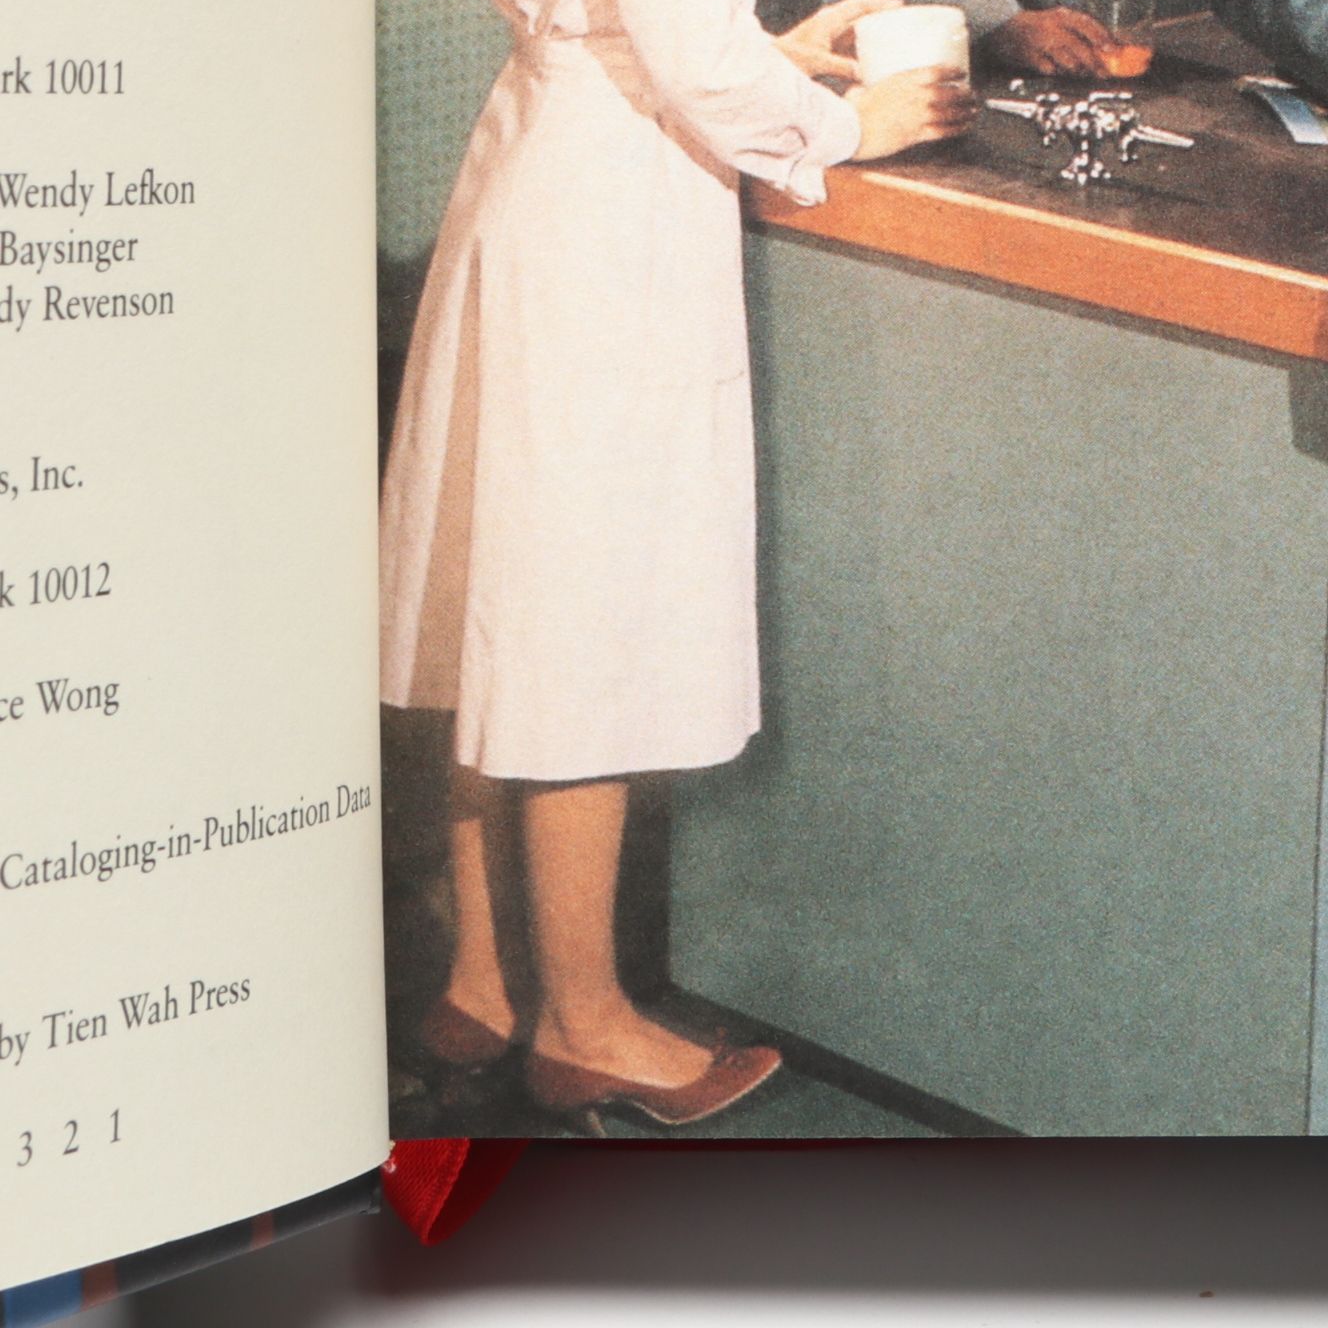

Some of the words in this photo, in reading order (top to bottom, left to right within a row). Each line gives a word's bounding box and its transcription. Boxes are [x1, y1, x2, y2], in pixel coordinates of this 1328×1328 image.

[0, 55, 32, 95] rk
[45, 59, 126, 95] 10011
[0, 169, 95, 217] Wendy
[105, 167, 196, 207] Lefkon
[0, 228, 139, 273] Baysinger
[0, 285, 31, 332] dy
[42, 285, 175, 322] Revenson
[30, 456, 84, 492] Inc.
[29, 562, 112, 606] 10012
[36, 678, 120, 716] Wong
[0, 796, 330, 891] Cataloging-in-Publication
[336, 783, 371, 822] Data
[0, 1023, 30, 1066] by
[42, 1009, 108, 1050] Tien
[119, 985, 179, 1030] Wah
[189, 977, 251, 1015] Press
[16, 1130, 34, 1167] 3
[62, 1119, 80, 1156] 2
[109, 1108, 123, 1144] 1
